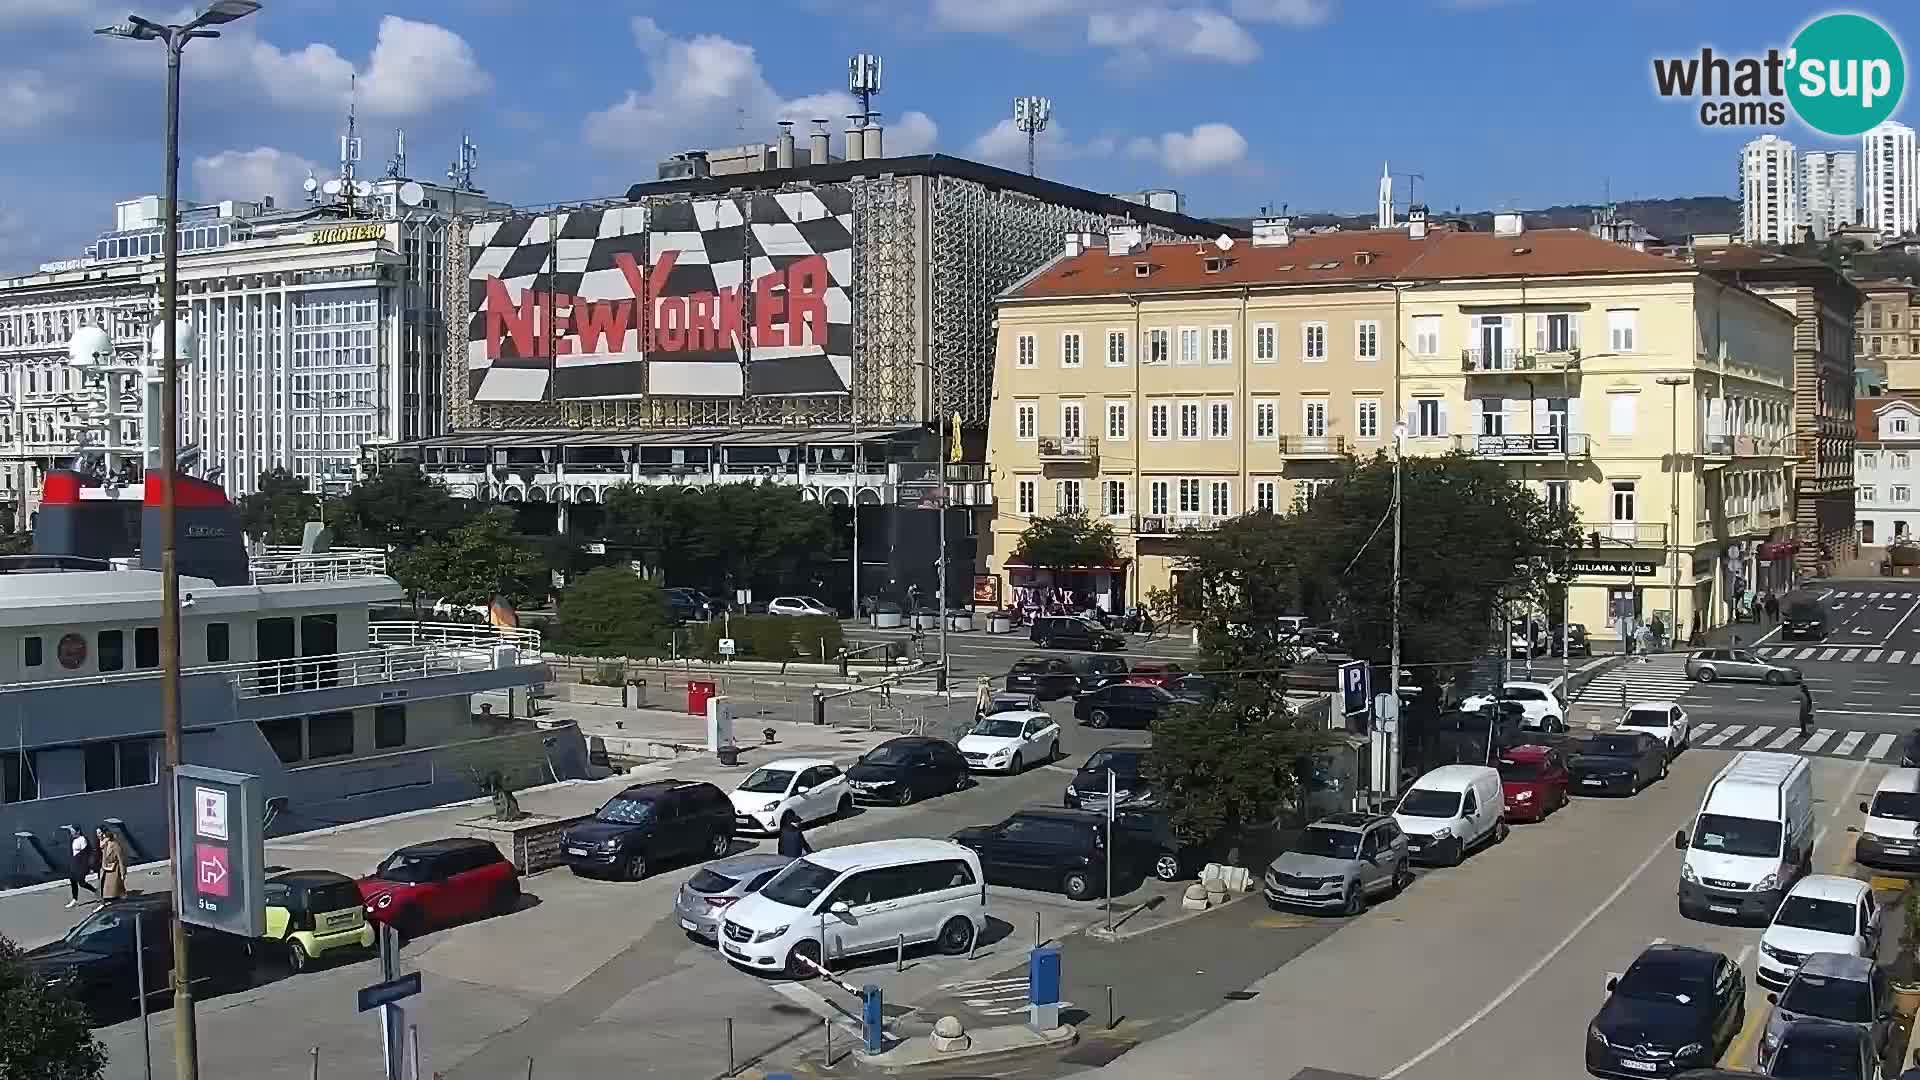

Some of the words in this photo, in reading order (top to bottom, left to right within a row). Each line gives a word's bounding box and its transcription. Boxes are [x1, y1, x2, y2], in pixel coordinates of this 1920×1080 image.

[487, 274, 632, 360] NEW
[613, 250, 828, 352] YORKER
[1571, 563, 1616, 572] JULIANA
[1621, 564, 1651, 573] NAILS
